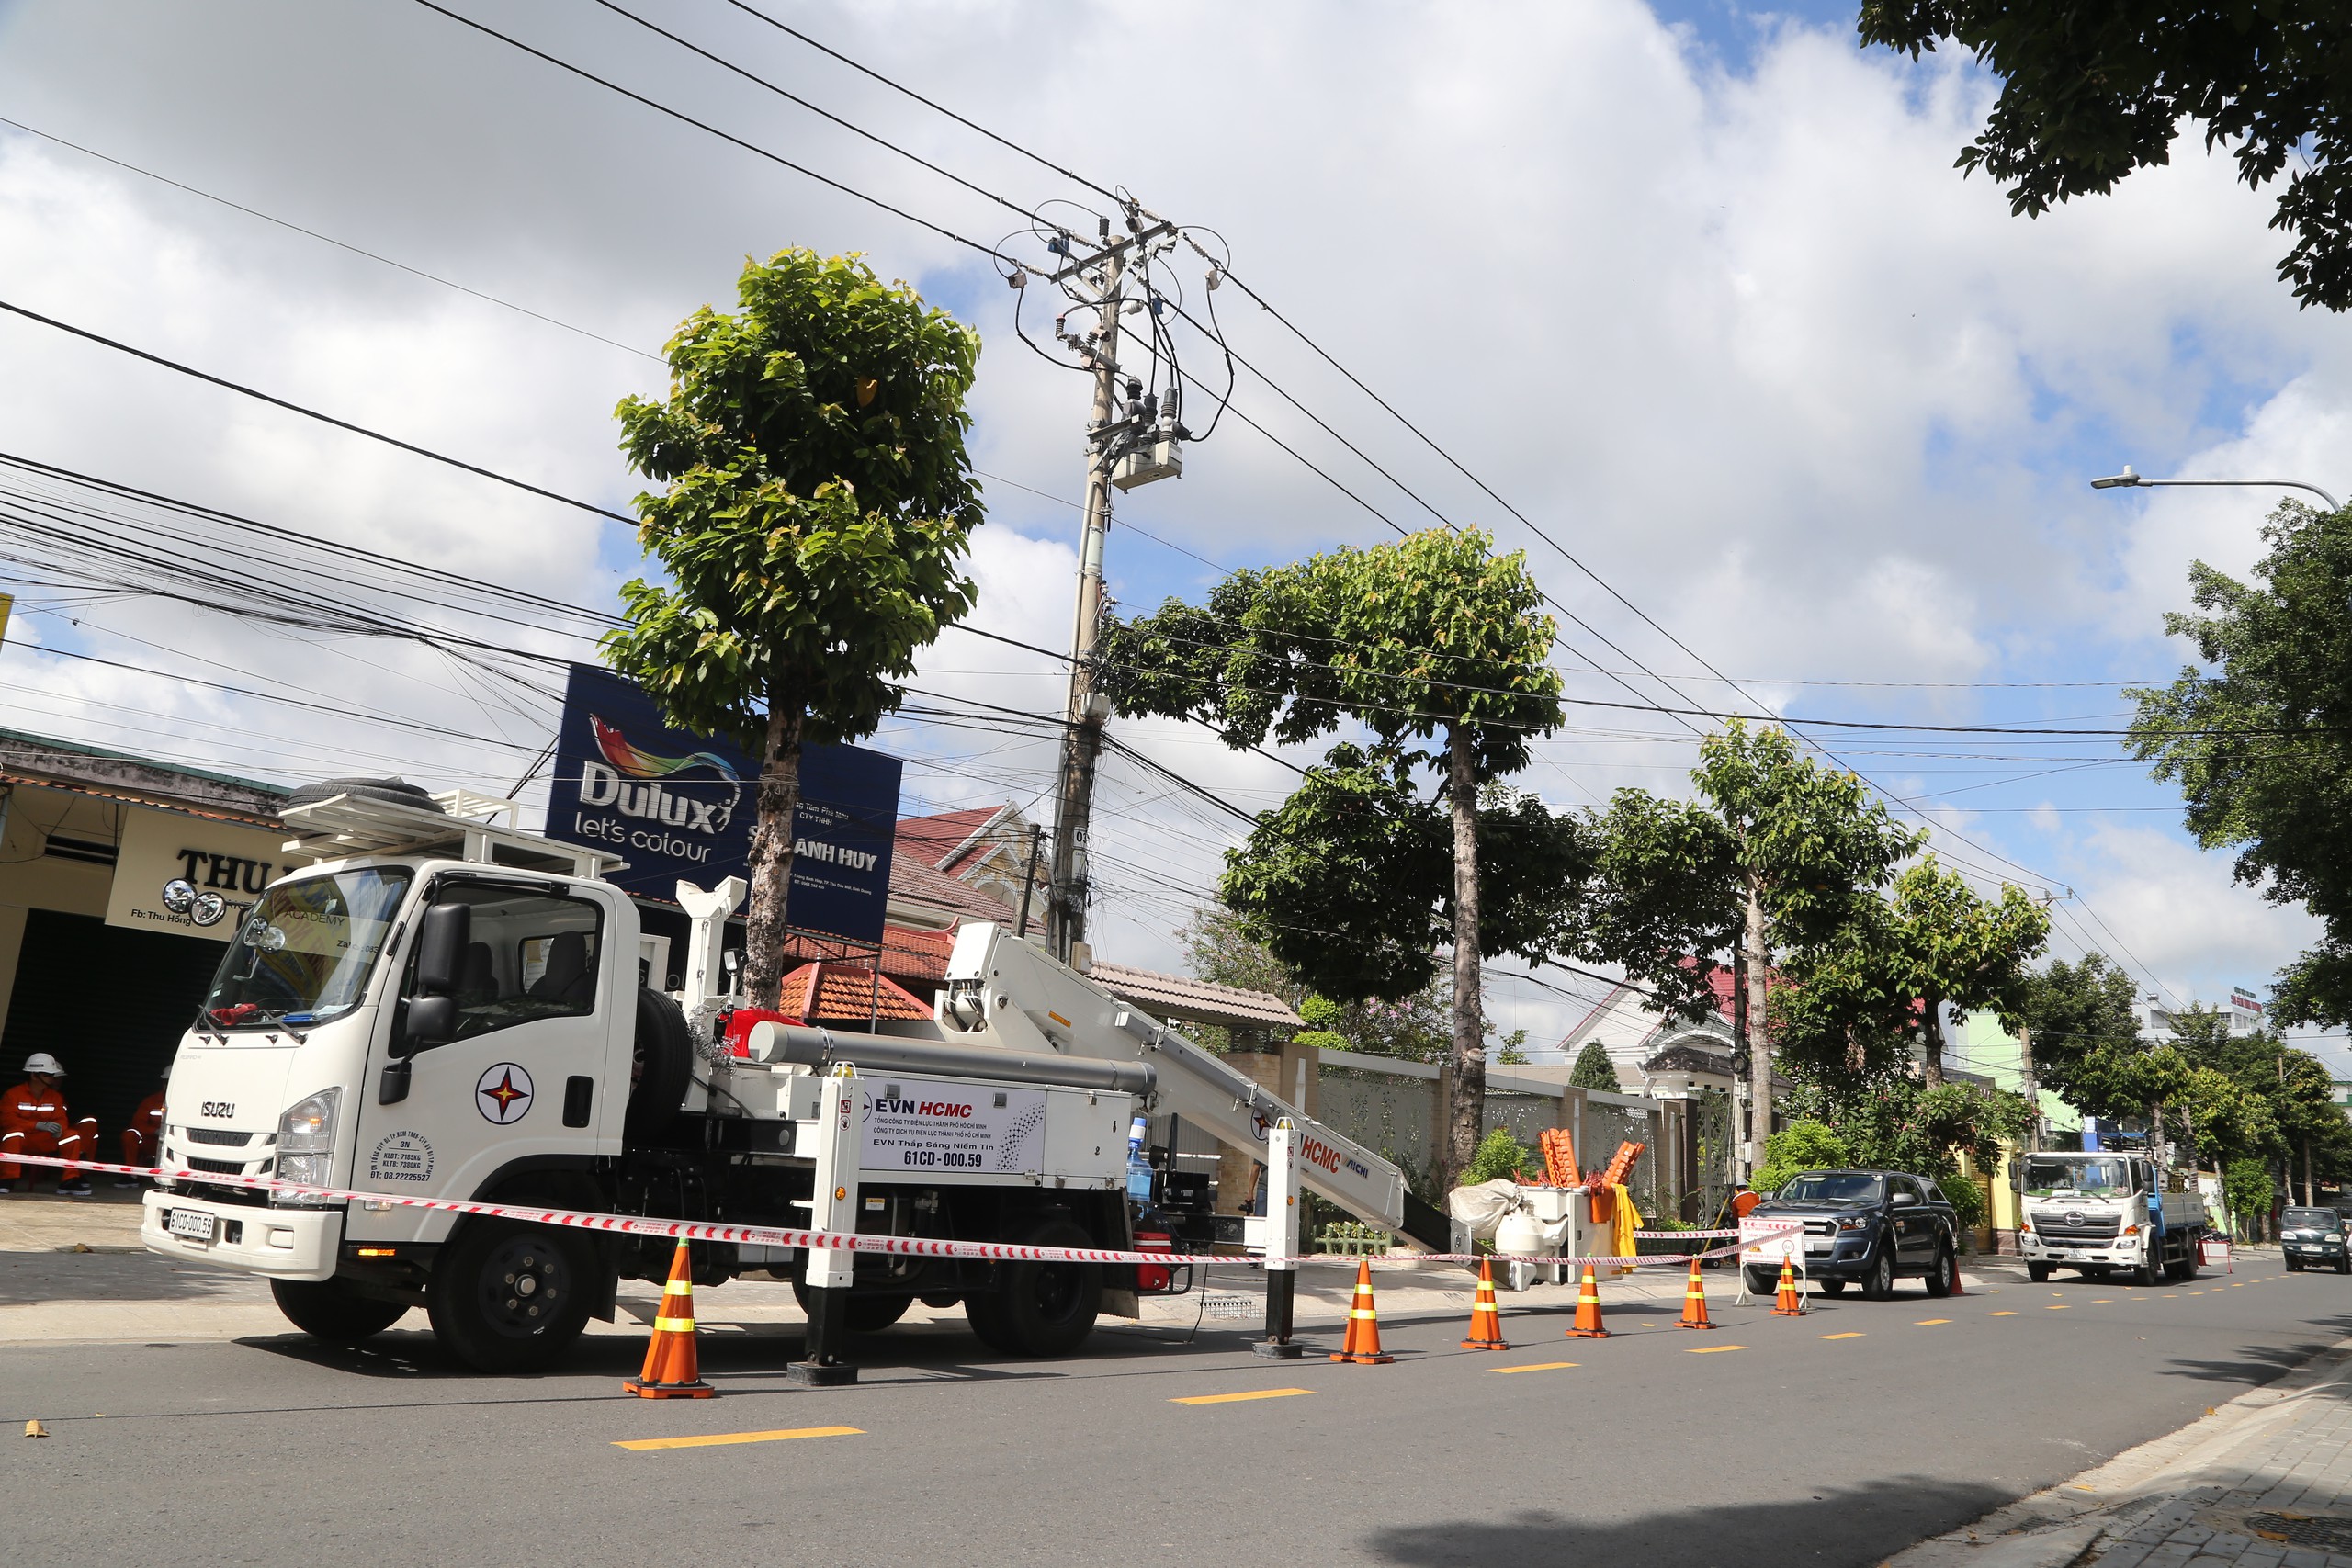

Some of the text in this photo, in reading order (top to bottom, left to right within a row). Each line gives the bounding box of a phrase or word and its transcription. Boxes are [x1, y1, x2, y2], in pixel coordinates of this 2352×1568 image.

[580, 760, 718, 835] Dulux
[799, 812, 814, 820] CTY
[575, 812, 625, 843] let's
[630, 830, 712, 863] colour
[838, 848, 877, 871] HUY
[176, 849, 273, 895] THU
[130, 908, 146, 919] Fb:
[148, 910, 164, 921] Thu
[285, 909, 345, 927] ACADEMY
[200, 1101, 235, 1118] ISUZU
[876, 1098, 973, 1119] EVN HCMC
[400, 1140, 411, 1148] 3N
[383, 1152, 421, 1161] KLBT: 7185KG
[1301, 1135, 1341, 1174] HCMC
[383, 1171, 431, 1182] 08.22225527
[170, 1213, 212, 1235] 61CD-000.59
